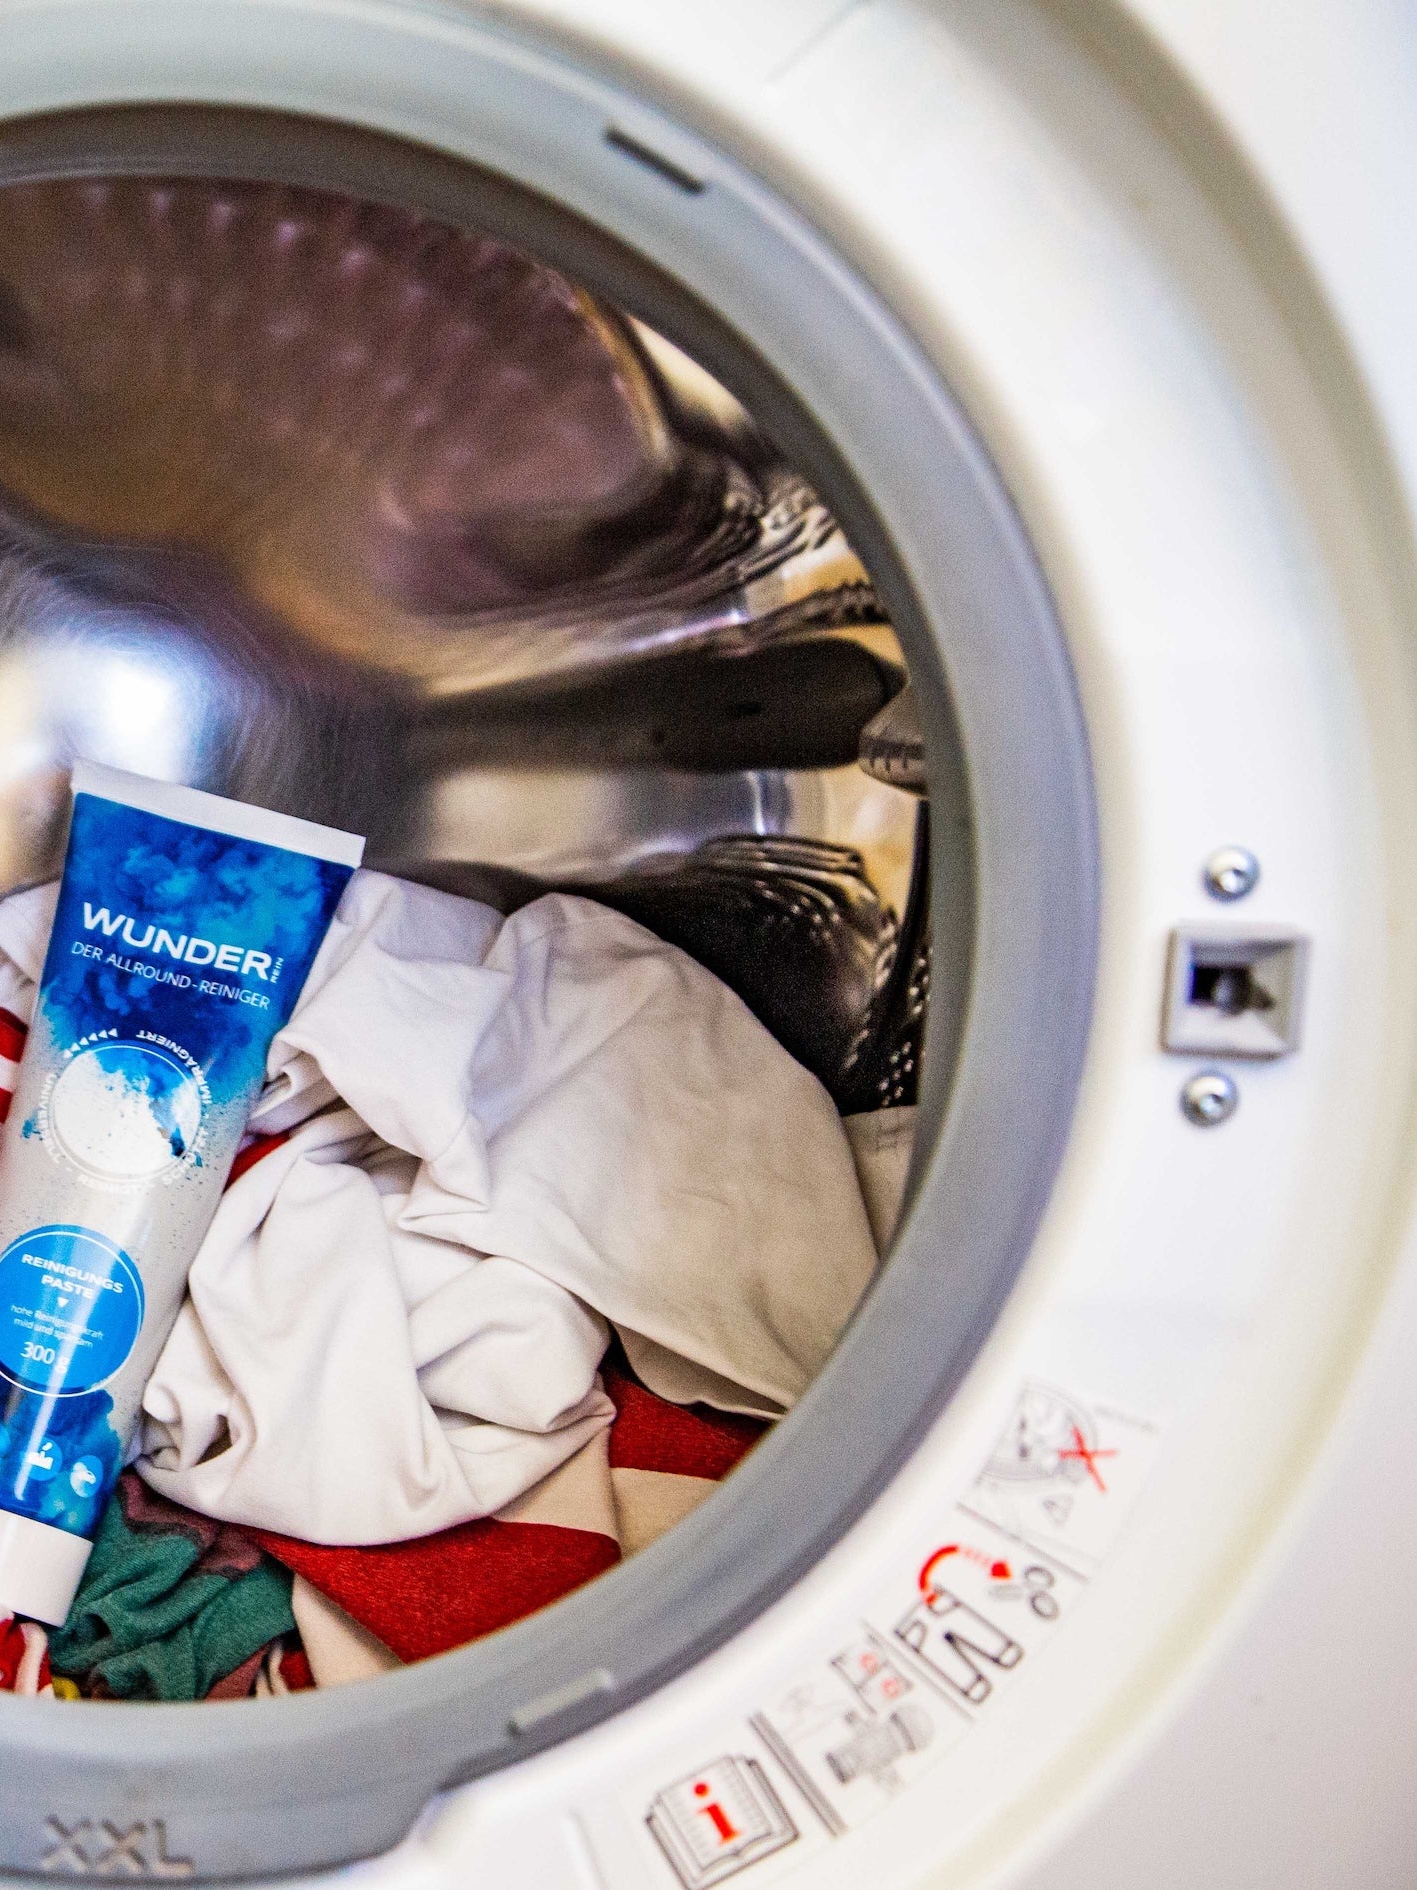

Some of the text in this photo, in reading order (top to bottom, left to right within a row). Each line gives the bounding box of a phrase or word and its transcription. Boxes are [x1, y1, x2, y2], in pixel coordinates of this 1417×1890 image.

[72, 941, 103, 961] DER
[83, 902, 272, 981] WUNDER
[269, 956, 284, 984] REIN
[136, 1029, 212, 1104] IMPRÄGNIERT
[21, 1254, 124, 1294] REINIGUNGS
[41, 1275, 95, 1299] PASTE
[11, 1305, 33, 1318] hohe
[14, 1318, 34, 1330] mild
[20, 1341, 56, 1365] 300
[42, 1814, 195, 1876] XXL
